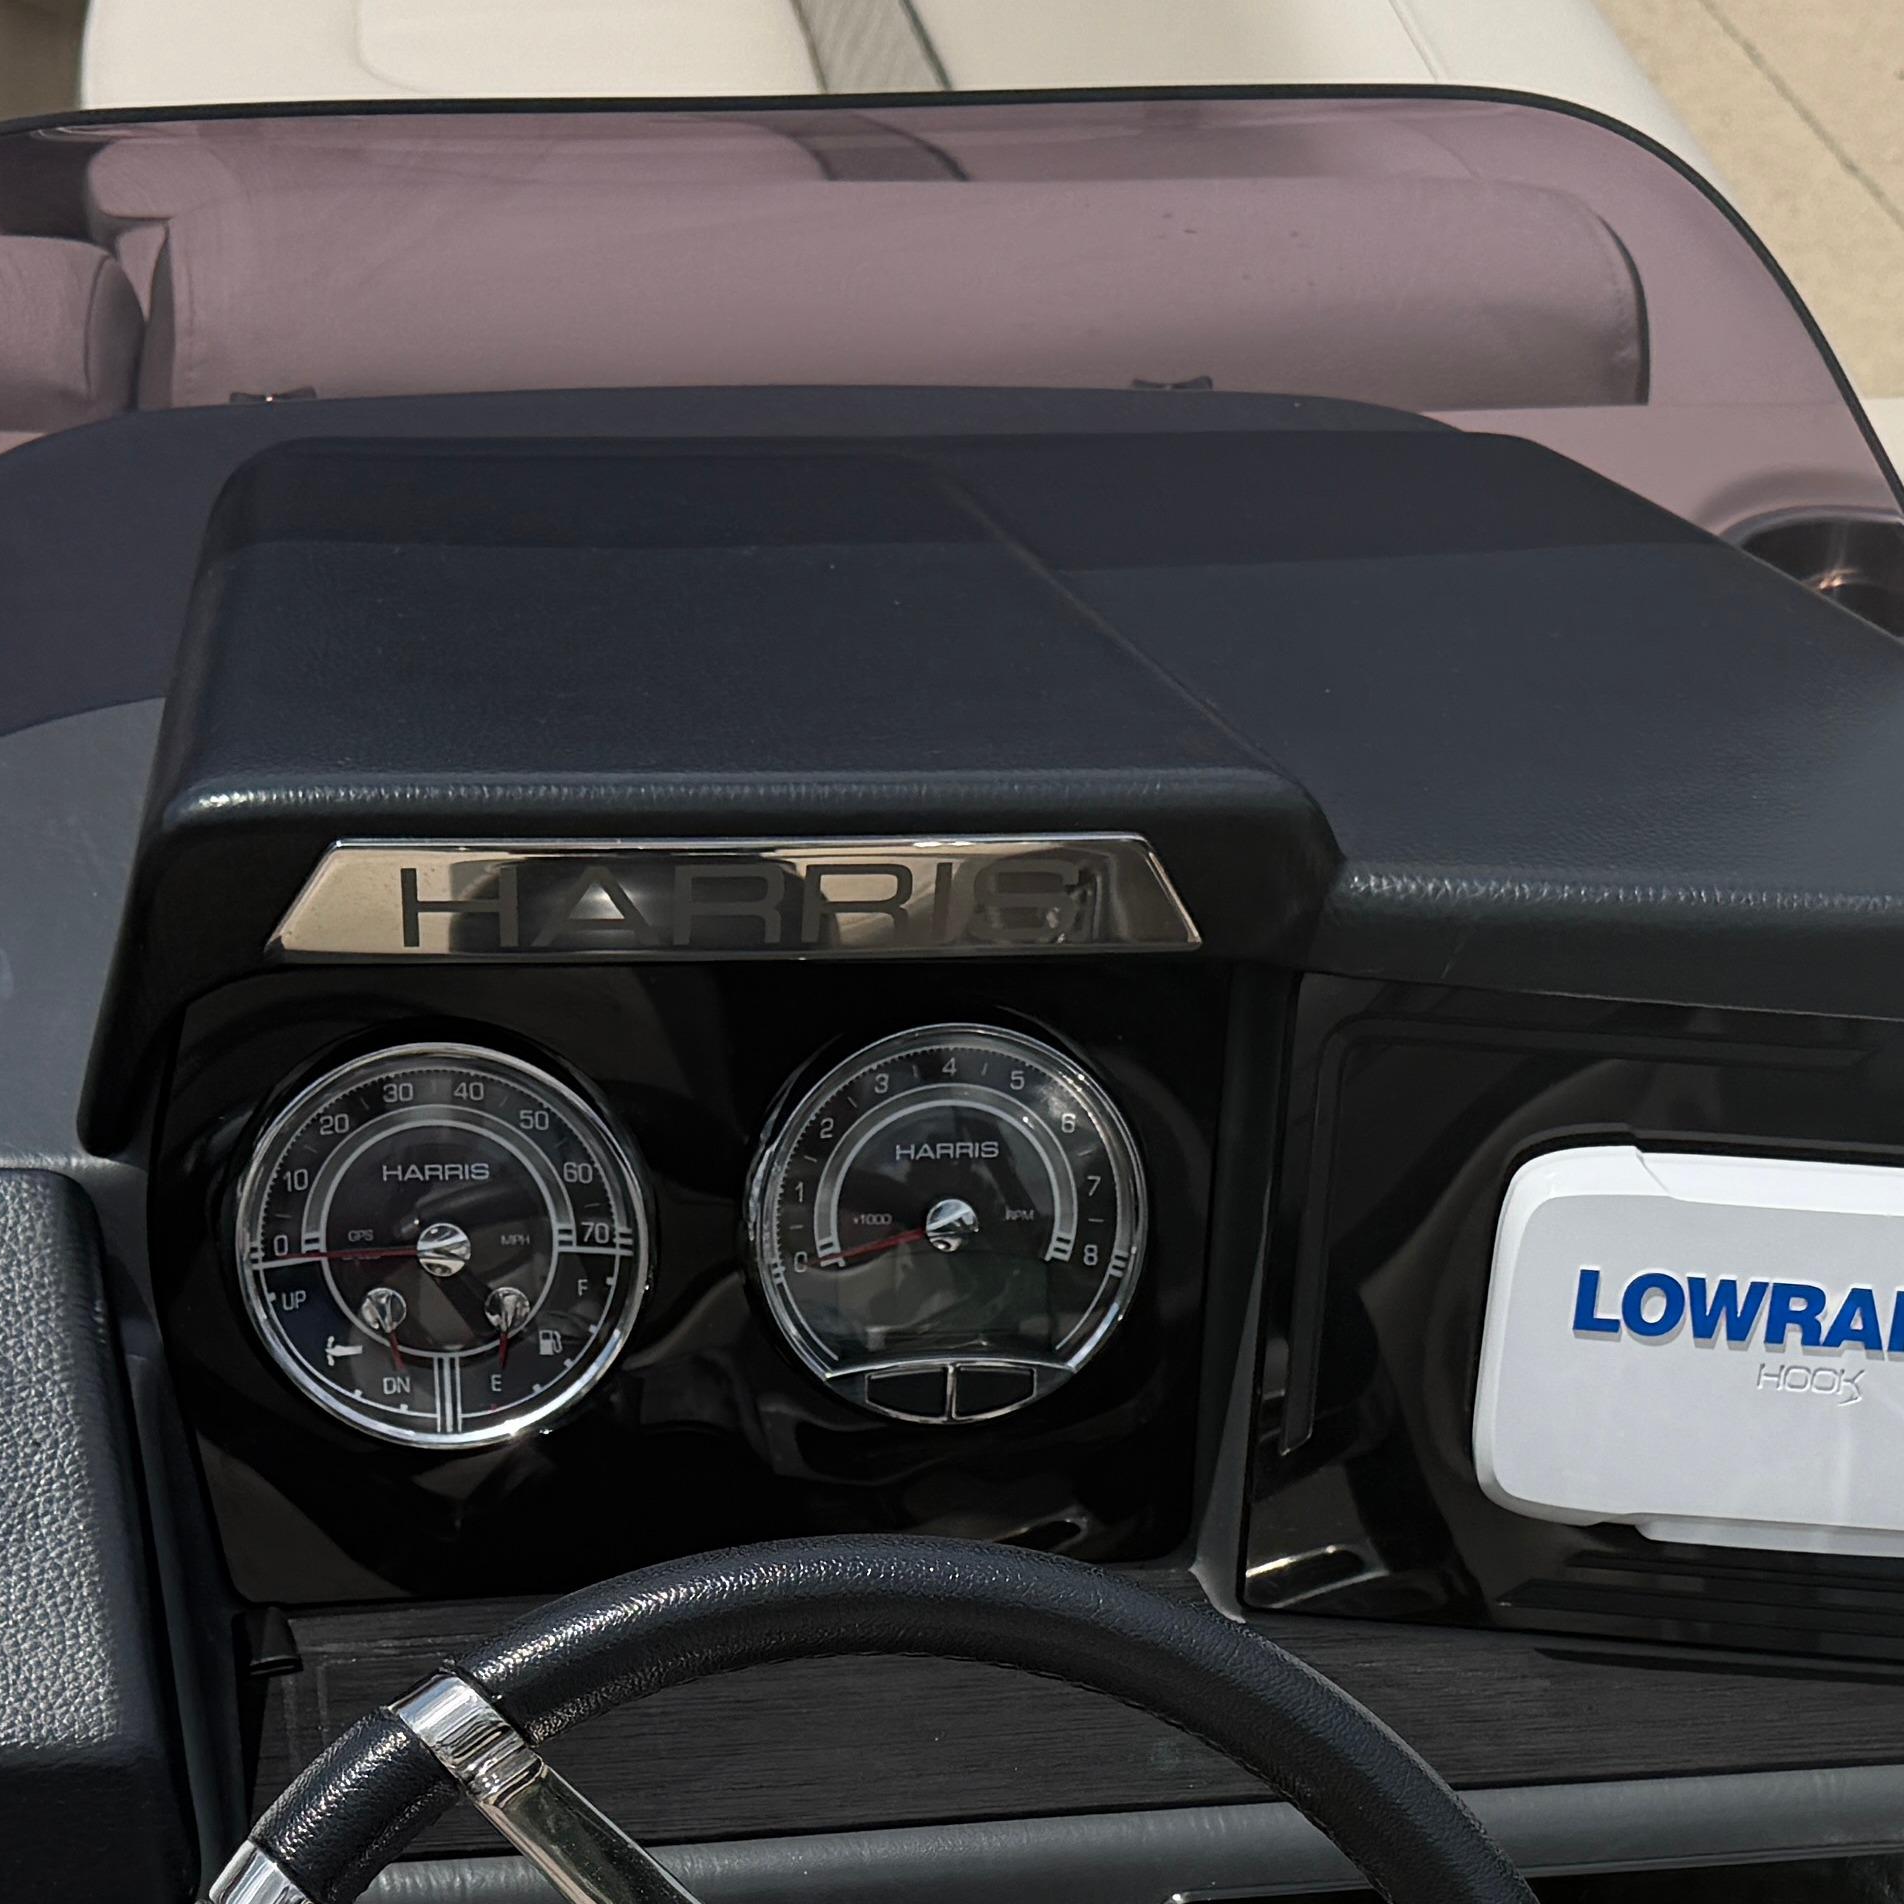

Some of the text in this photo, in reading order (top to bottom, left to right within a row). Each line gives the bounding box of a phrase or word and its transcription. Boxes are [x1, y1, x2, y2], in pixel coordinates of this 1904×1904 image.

[400, 861, 1082, 948] HARRIS
[942, 1057, 957, 1076] 4
[874, 1073, 889, 1094] 3
[1010, 1070, 1025, 1090] 5
[383, 1083, 413, 1103] 30
[454, 1082, 485, 1101] 40
[319, 1113, 349, 1135] 20
[519, 1110, 549, 1130] 50
[820, 1117, 834, 1139] 2
[1061, 1112, 1076, 1133] 6
[896, 1141, 1000, 1161] HARRIS
[283, 1168, 309, 1192] 10
[382, 1163, 490, 1182] HARRIS
[563, 1162, 593, 1184] 60
[794, 1182, 804, 1203] 1
[1087, 1175, 1101, 1197] 7
[1005, 1208, 1035, 1221] RPM
[347, 1229, 374, 1242] GPS
[500, 1234, 530, 1245] MPH
[581, 1222, 610, 1243] 70
[273, 1235, 288, 1256] 0
[1083, 1244, 1098, 1266] 8
[577, 1278, 588, 1297] F
[281, 1290, 307, 1311] UP
[382, 1375, 411, 1395] DN
[492, 1373, 502, 1392] E
[1755, 1361, 1866, 1406] HOOK
